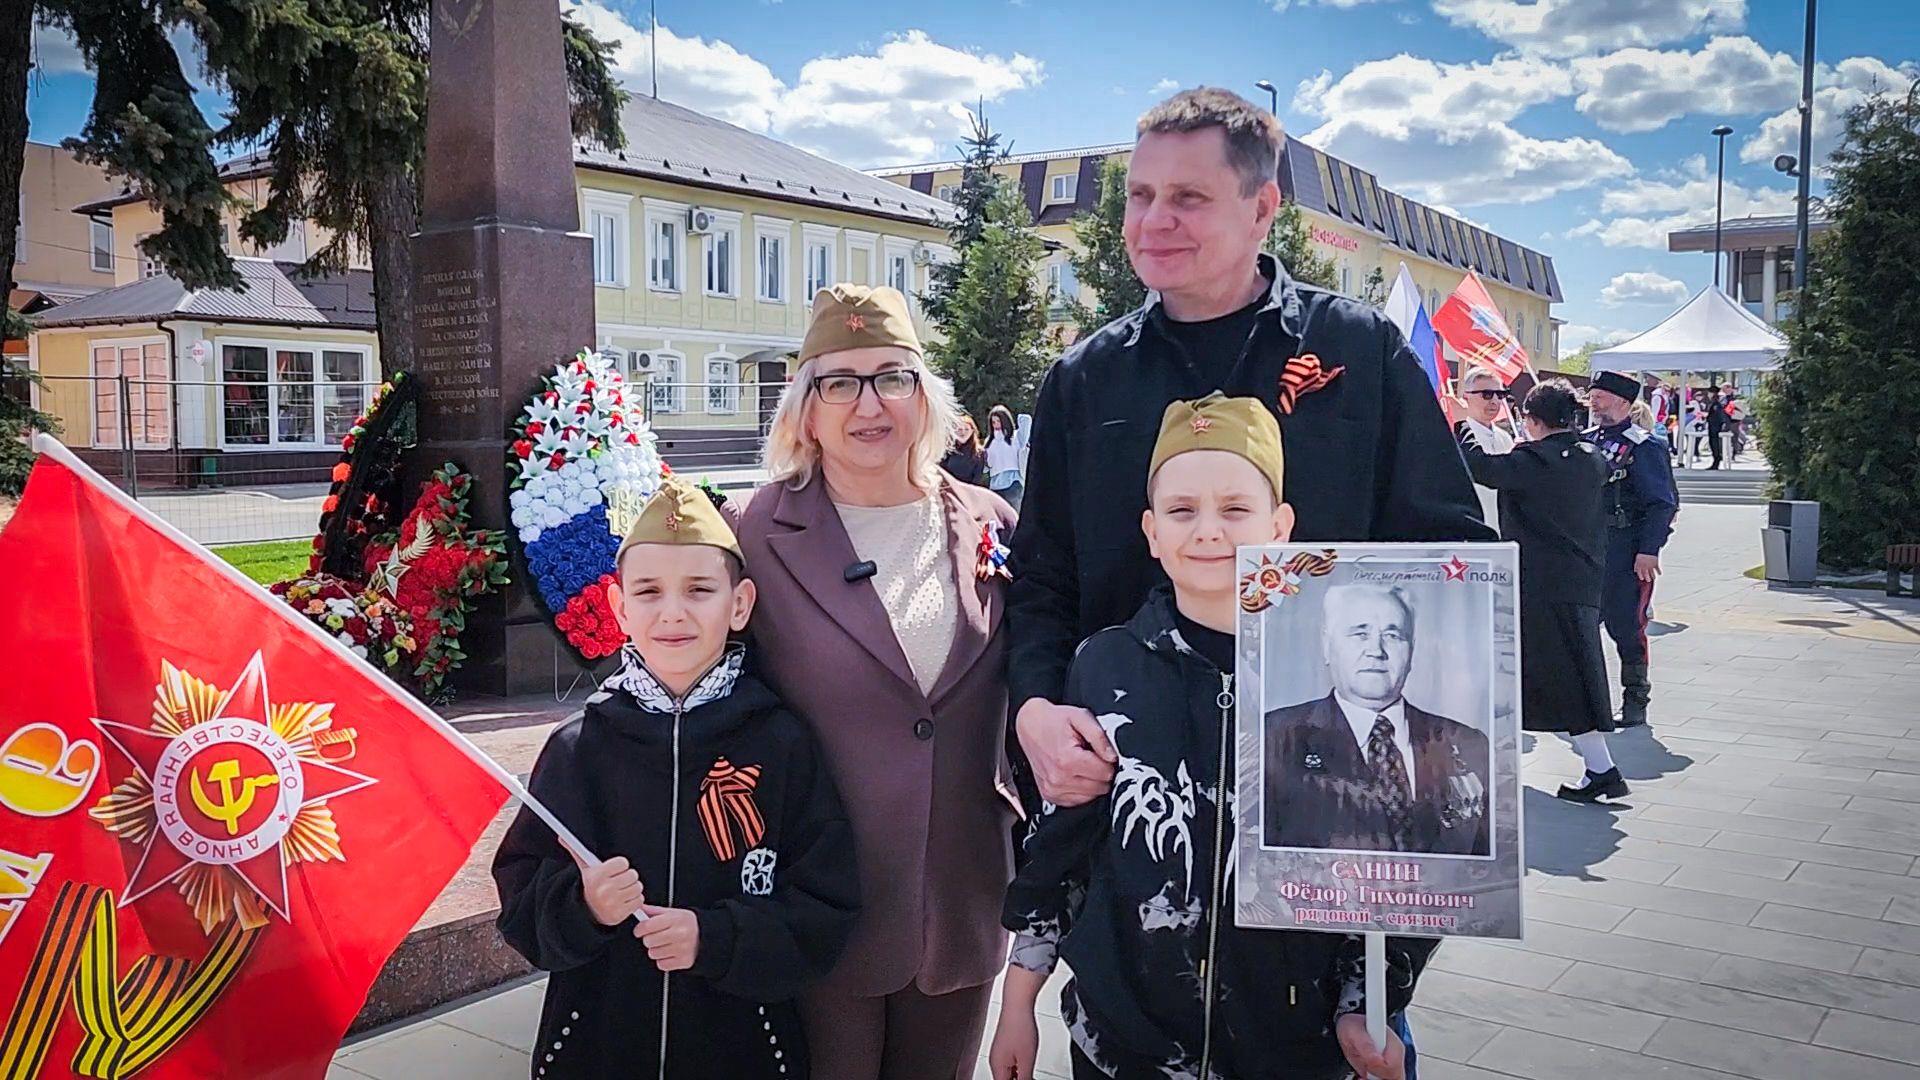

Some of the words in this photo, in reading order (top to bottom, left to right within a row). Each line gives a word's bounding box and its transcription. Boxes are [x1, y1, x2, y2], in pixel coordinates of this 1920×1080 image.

[1469, 571, 1507, 582] ПОЛК
[1331, 860, 1421, 881] САНИН
[1280, 881, 1349, 907] Фёдор
[1354, 885, 1475, 909] Тихонович
[1295, 907, 1370, 925] рядовой
[1386, 912, 1458, 929] связист
